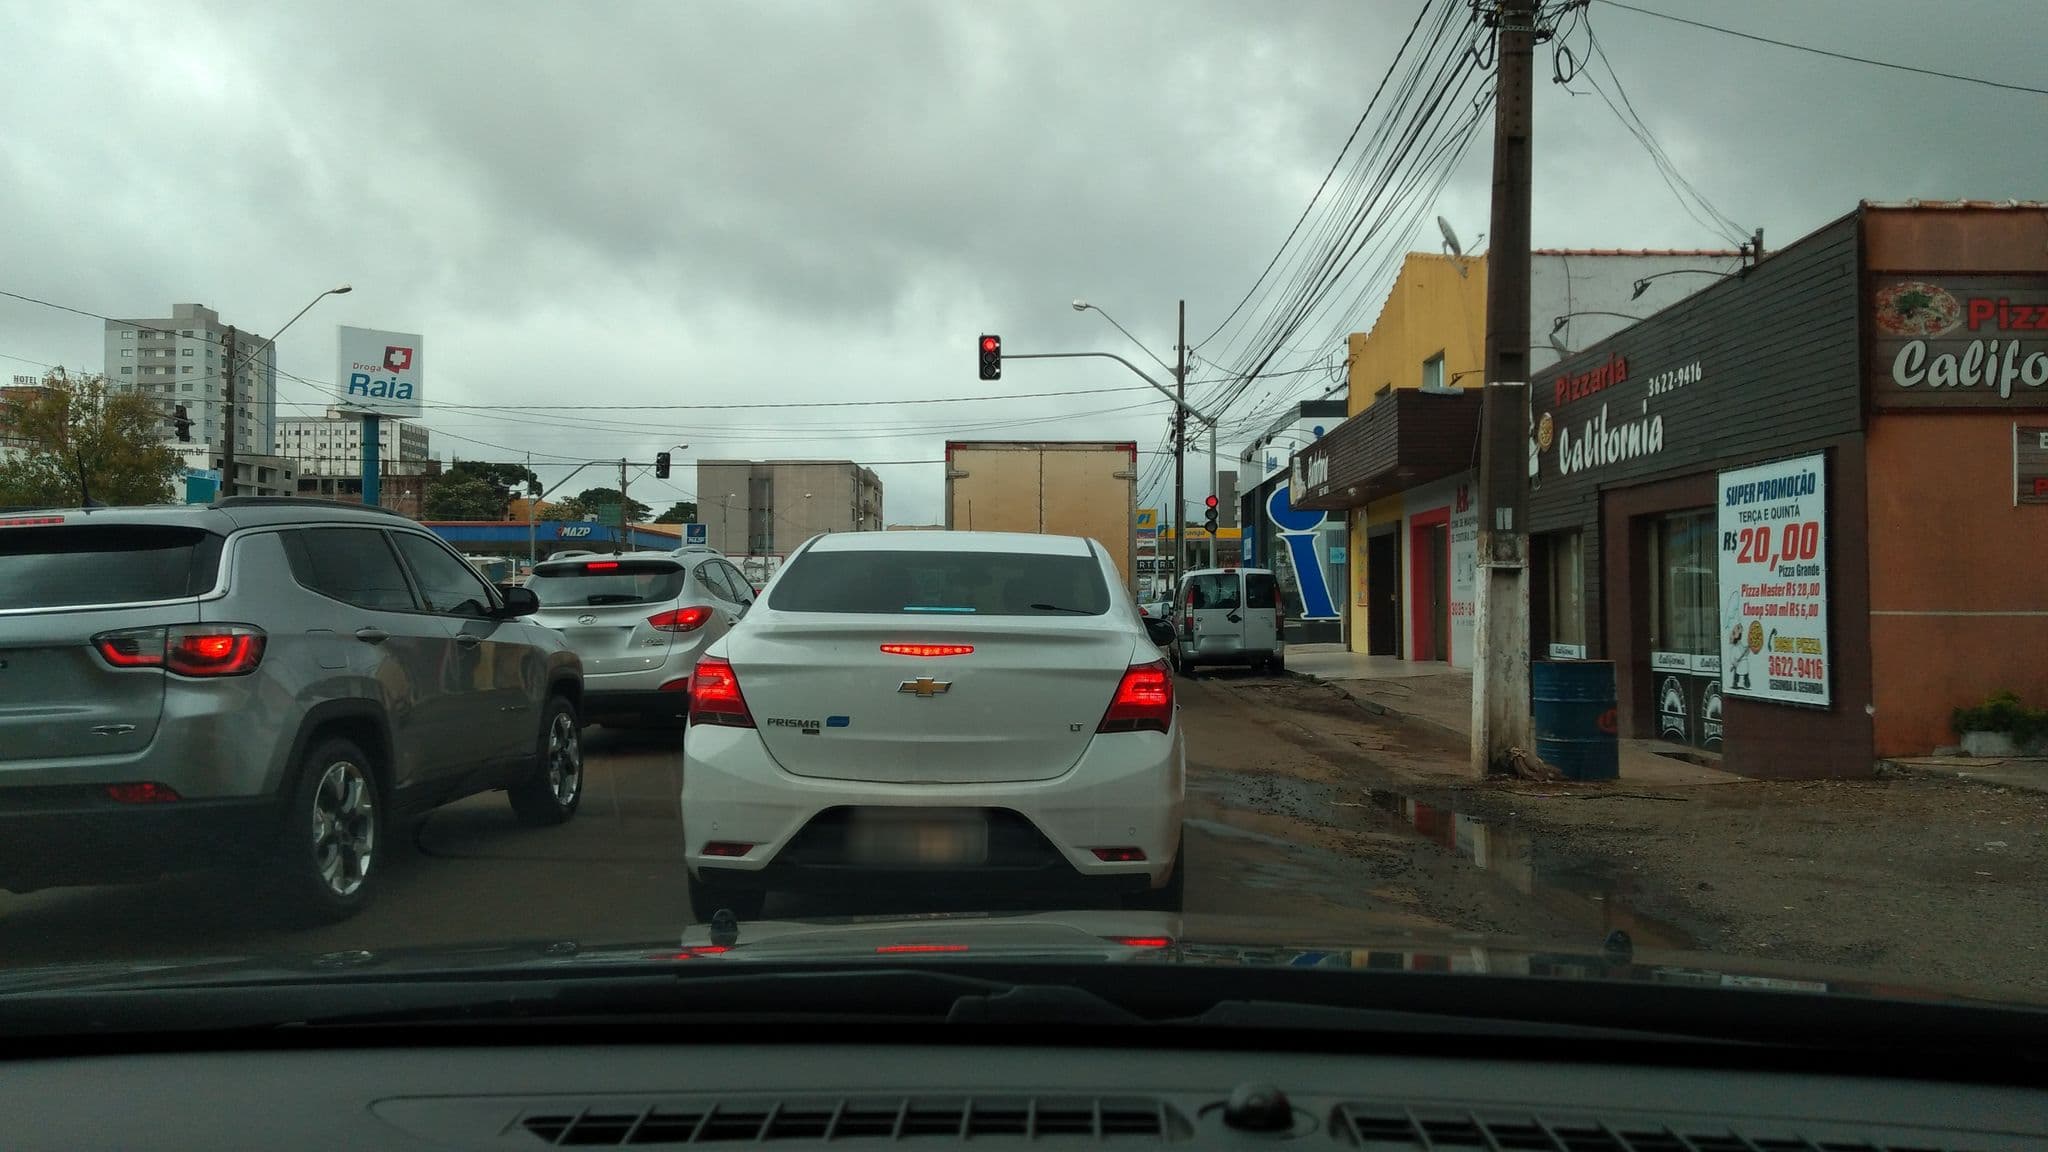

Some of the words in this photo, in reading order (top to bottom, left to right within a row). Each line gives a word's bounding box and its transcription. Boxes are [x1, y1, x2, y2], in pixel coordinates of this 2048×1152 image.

[352, 362, 382, 373] Droga
[13, 375, 37, 385] HOTEL
[348, 373, 414, 400] Raia
[1555, 352, 1628, 407] Pizzaria
[1648, 361, 1702, 398] 3622-9416
[1559, 399, 1664, 476] California
[1726, 482, 1756, 507] SUPER
[1756, 469, 1816, 503] PROMOÇÃO
[1738, 509, 1762, 525] TERÇA
[1764, 508, 1769, 520] E
[561, 526, 591, 537] MAZP
[1723, 530, 1738, 554] R$
[1737, 521, 1819, 573] 20,00
[1778, 565, 1795, 577] Pizza
[1796, 563, 1820, 577] Grande
[1741, 583, 1760, 598] Pizza
[1760, 582, 1786, 597] Master
[1797, 582, 1820, 599] 28,00
[1765, 603, 1778, 616] 500
[1768, 655, 1823, 680] 3622-9416
[767, 717, 821, 729] PRISMA
[1070, 722, 1084, 732] LT
